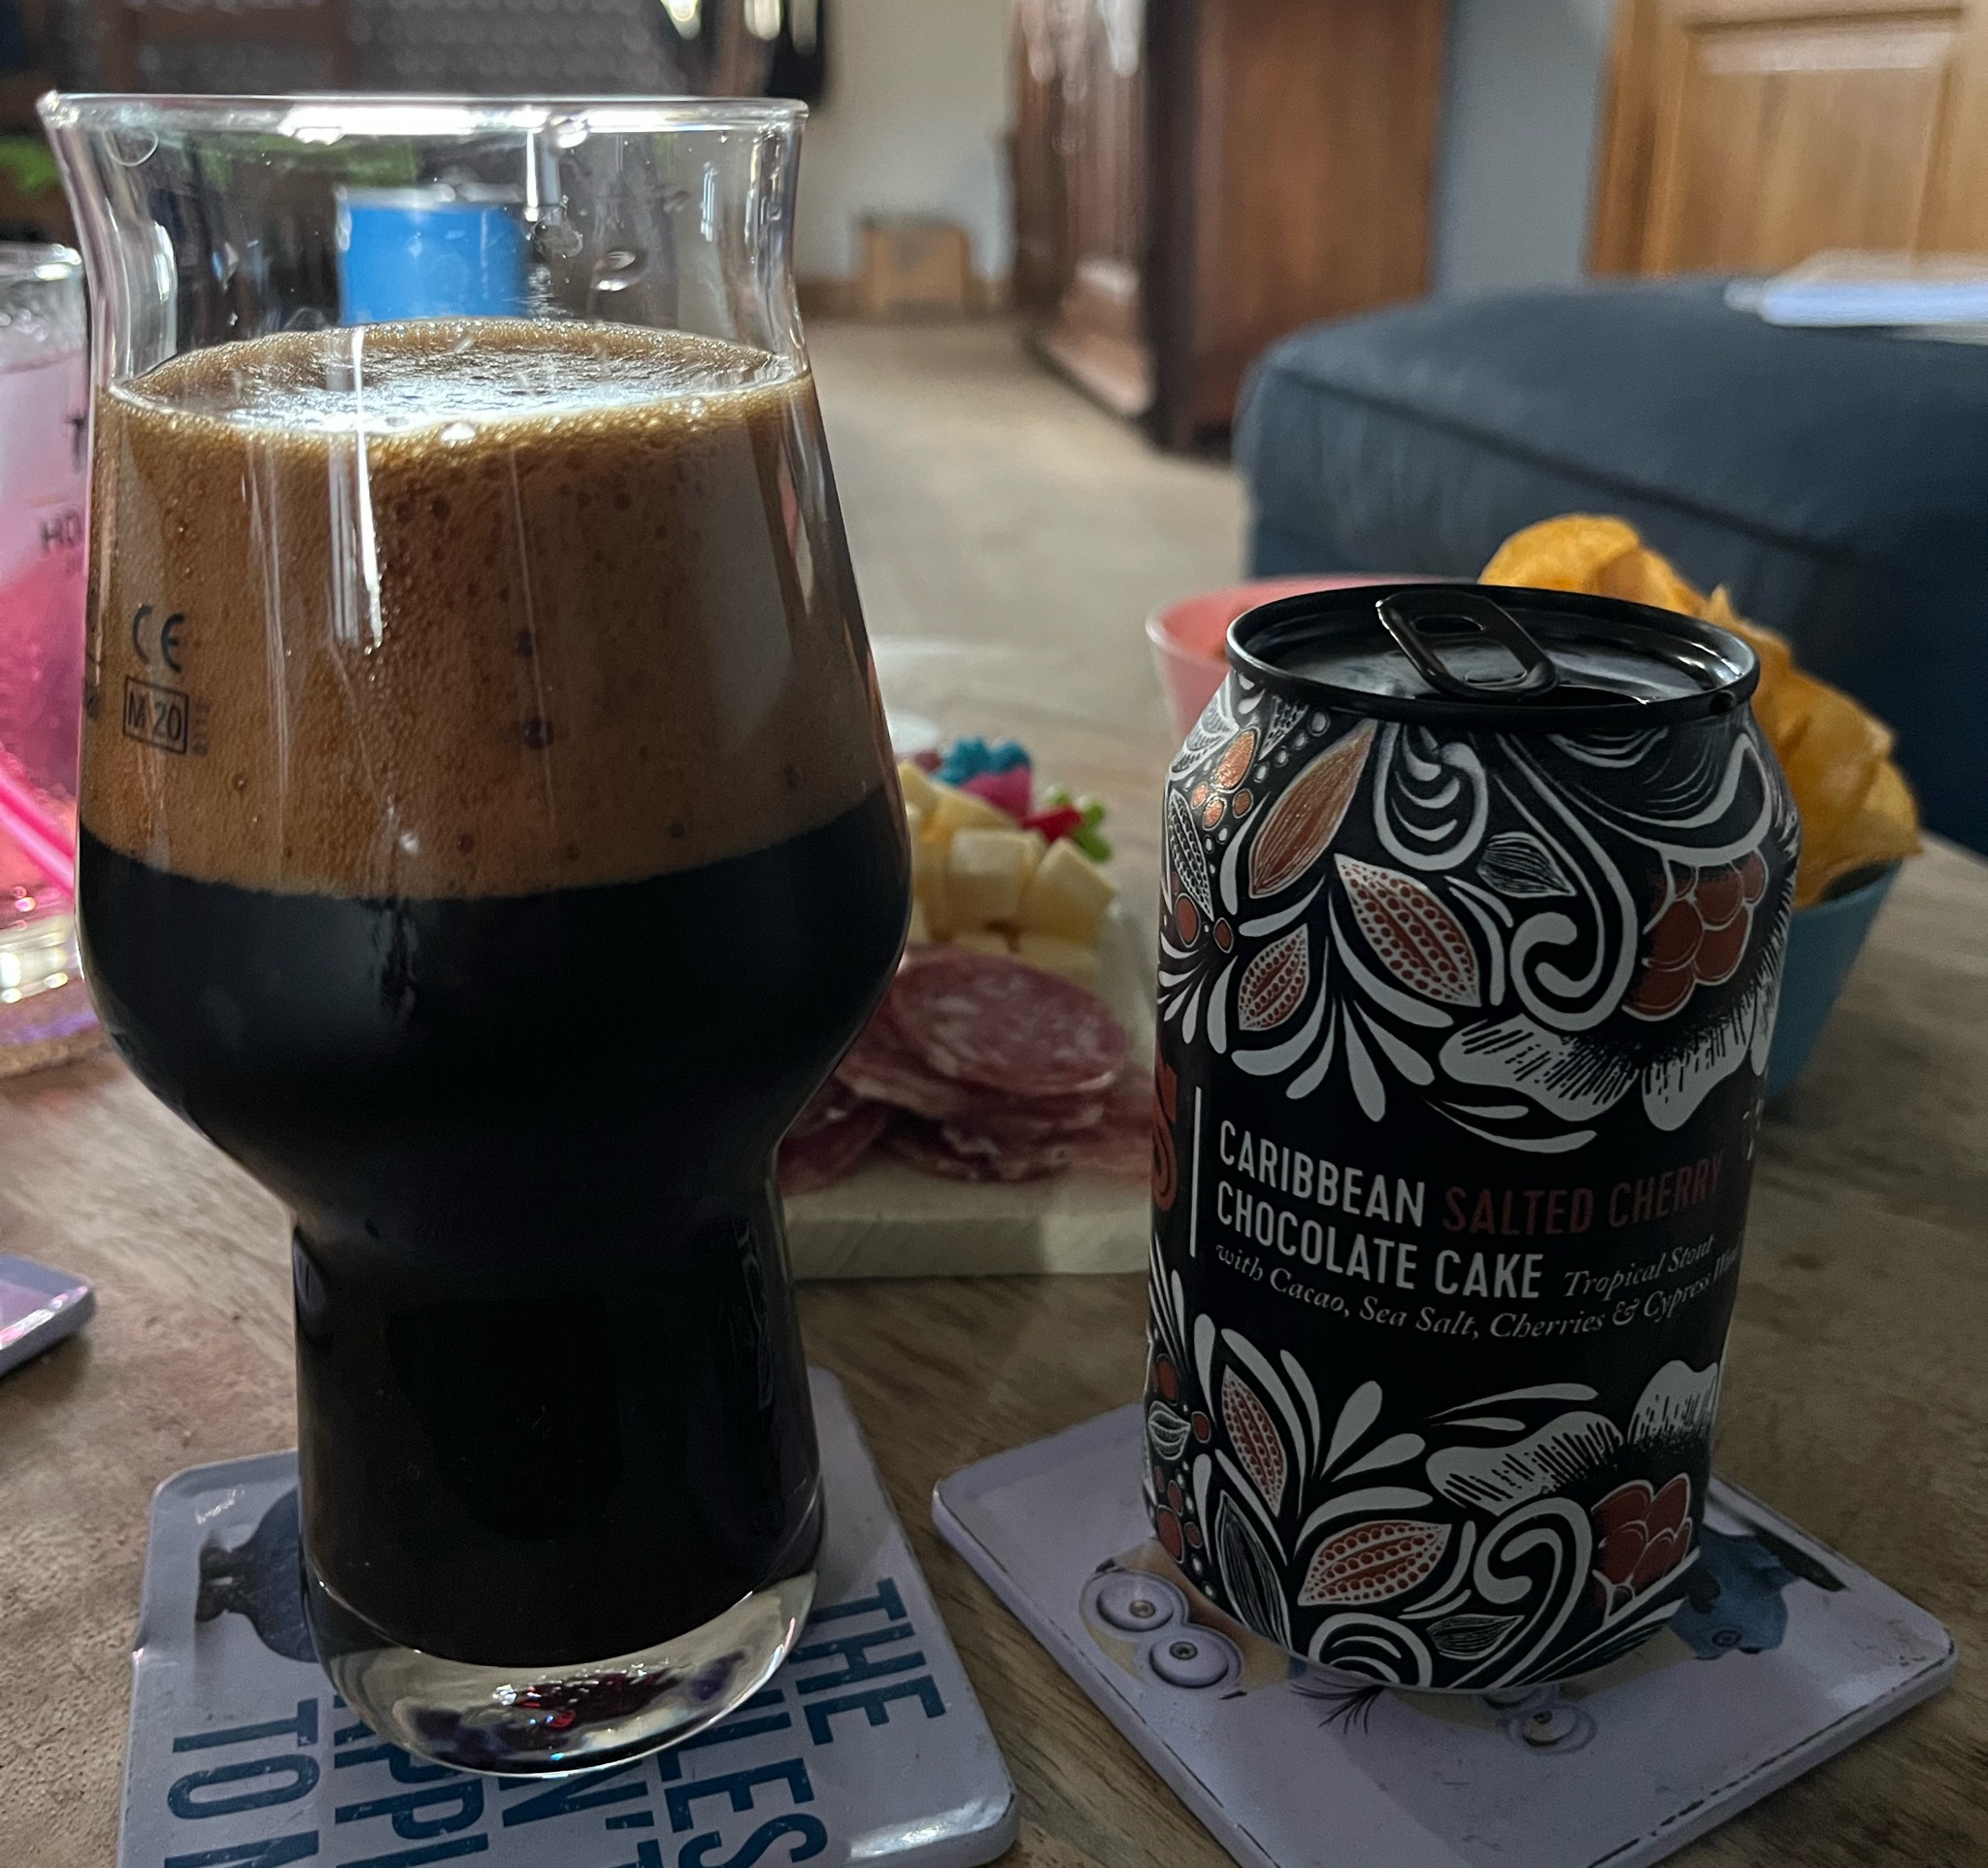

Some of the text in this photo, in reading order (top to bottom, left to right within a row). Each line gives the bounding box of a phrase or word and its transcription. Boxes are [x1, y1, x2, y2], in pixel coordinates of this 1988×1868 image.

[132, 603, 185, 675] CE
[1219, 1118, 1426, 1228] CARIBBEAN
[1441, 1184, 1596, 1237] SALTED
[1607, 1149, 1725, 1229] CHERRY
[1214, 1243, 1264, 1283] with
[1269, 1266, 1351, 1318] Cacao,
[1358, 1294, 1408, 1328] Sea
[1414, 1305, 1480, 1341] Salt,
[1488, 1310, 1607, 1339] Cherries
[1611, 1296, 1641, 1327] &
[1642, 1270, 1713, 1323] Cypress
[1215, 1180, 1544, 1300] CHOCOLATE CAKE
[1562, 1233, 1715, 1302] Tropical Stout
[786, 1577, 946, 1746] THE
[167, 1697, 321, 1820] TO
